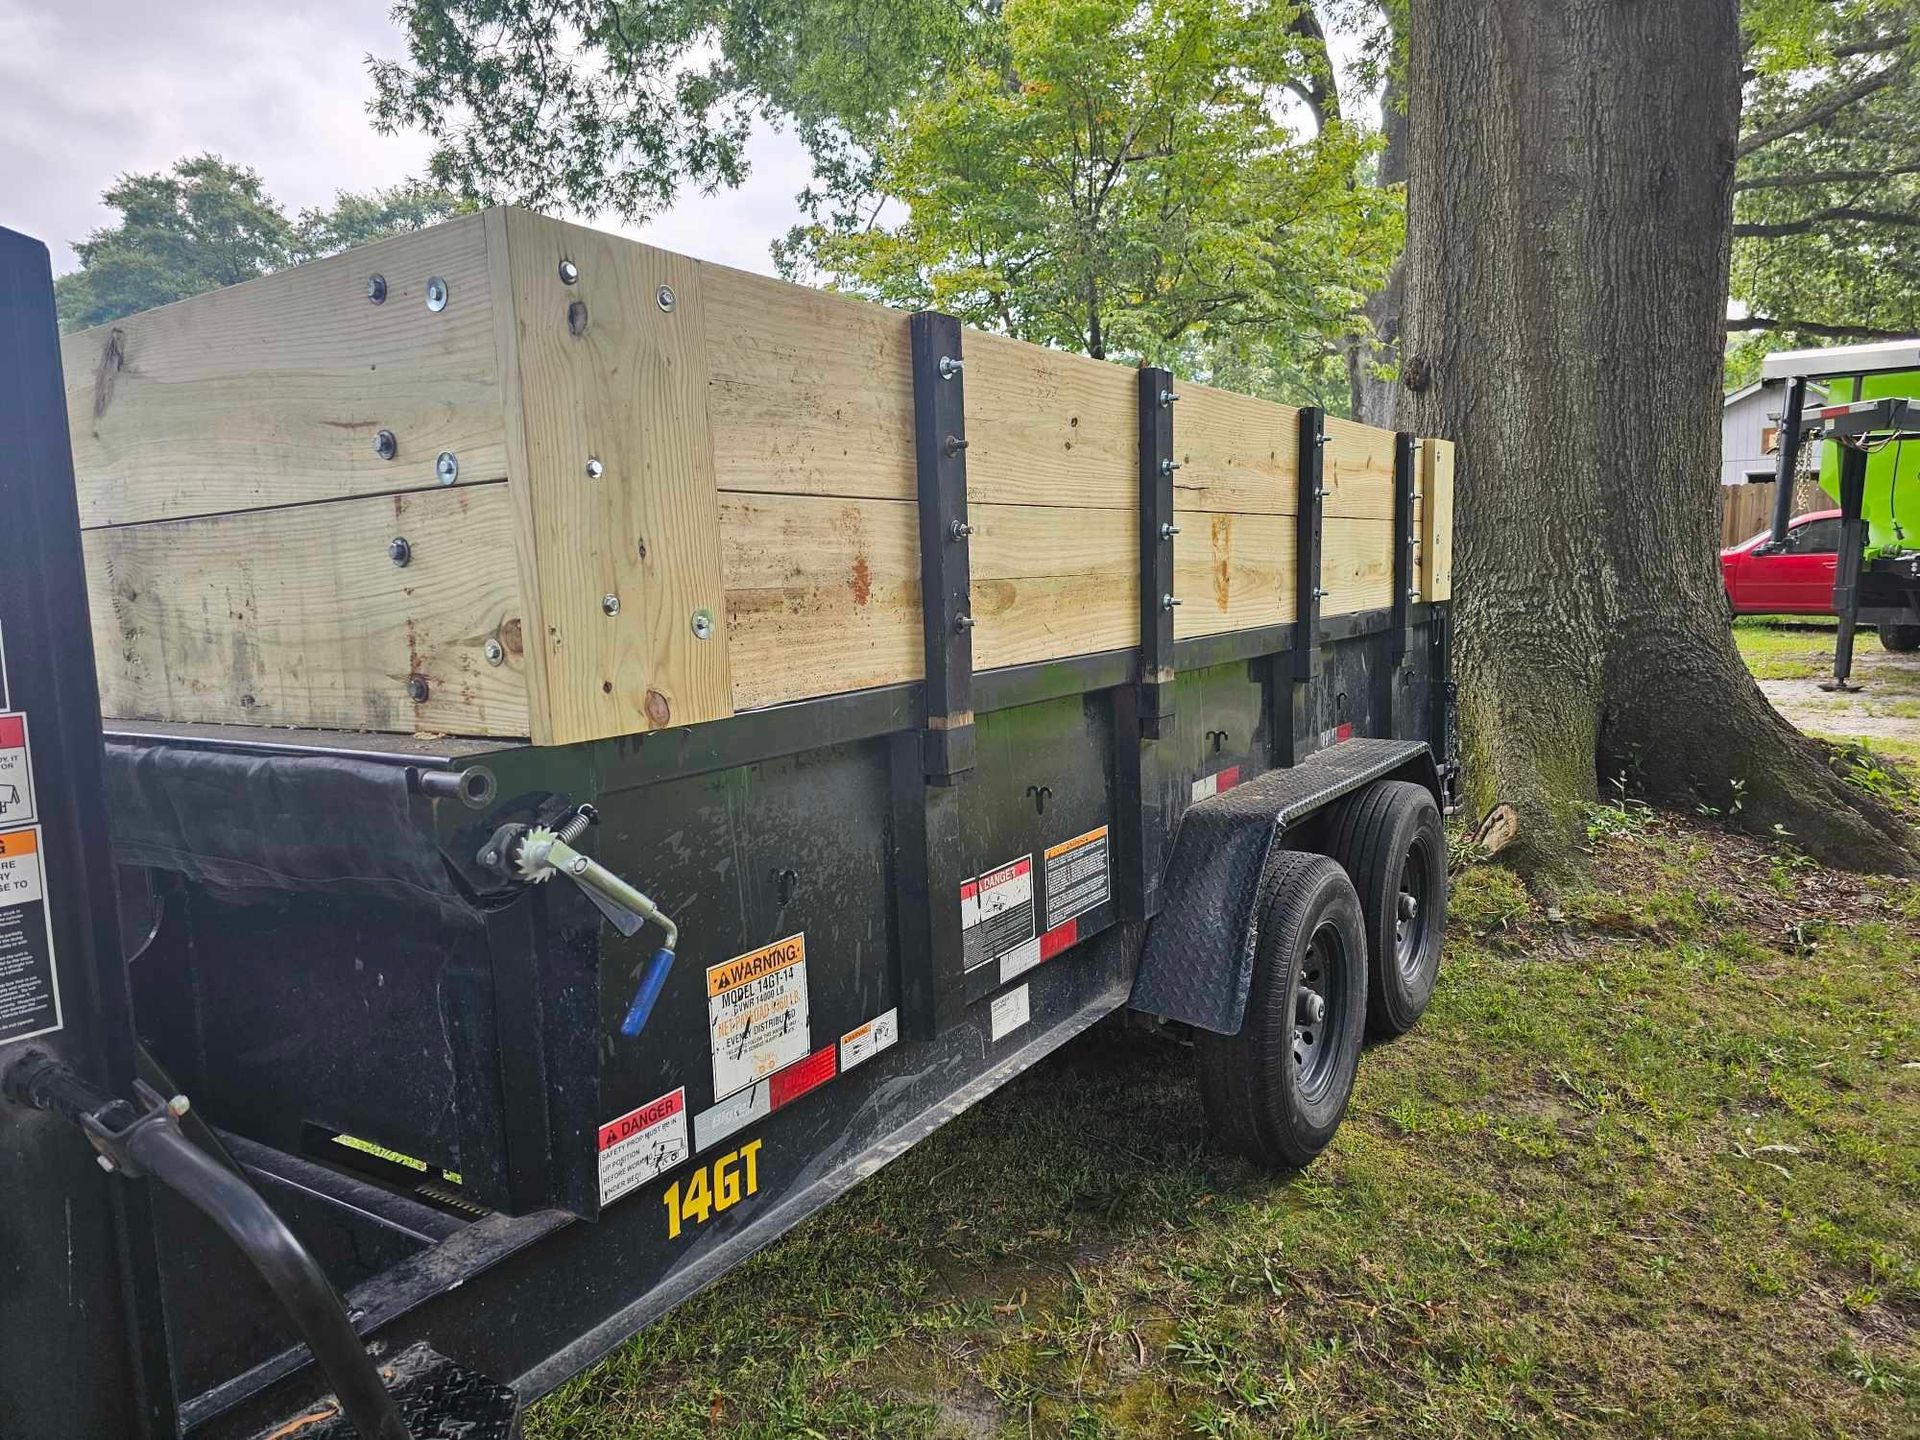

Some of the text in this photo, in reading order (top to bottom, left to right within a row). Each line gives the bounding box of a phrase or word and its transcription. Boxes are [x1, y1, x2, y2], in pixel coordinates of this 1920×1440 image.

[13, 879, 28, 890] TO
[983, 866, 1016, 891] DANGER
[731, 944, 797, 984] WARNING
[721, 967, 794, 1009] MODEL 14GT-14
[733, 997, 755, 1016] GVWR
[621, 1099, 675, 1137] DANGER
[601, 1144, 626, 1162] SAFETY
[627, 1136, 644, 1149] PROP
[644, 1126, 661, 1140] MUST
[671, 1118, 677, 1126] IN
[612, 1149, 640, 1169] POSITION
[603, 1168, 627, 1186] BEFORE
[663, 1137, 763, 1241] 14GT
